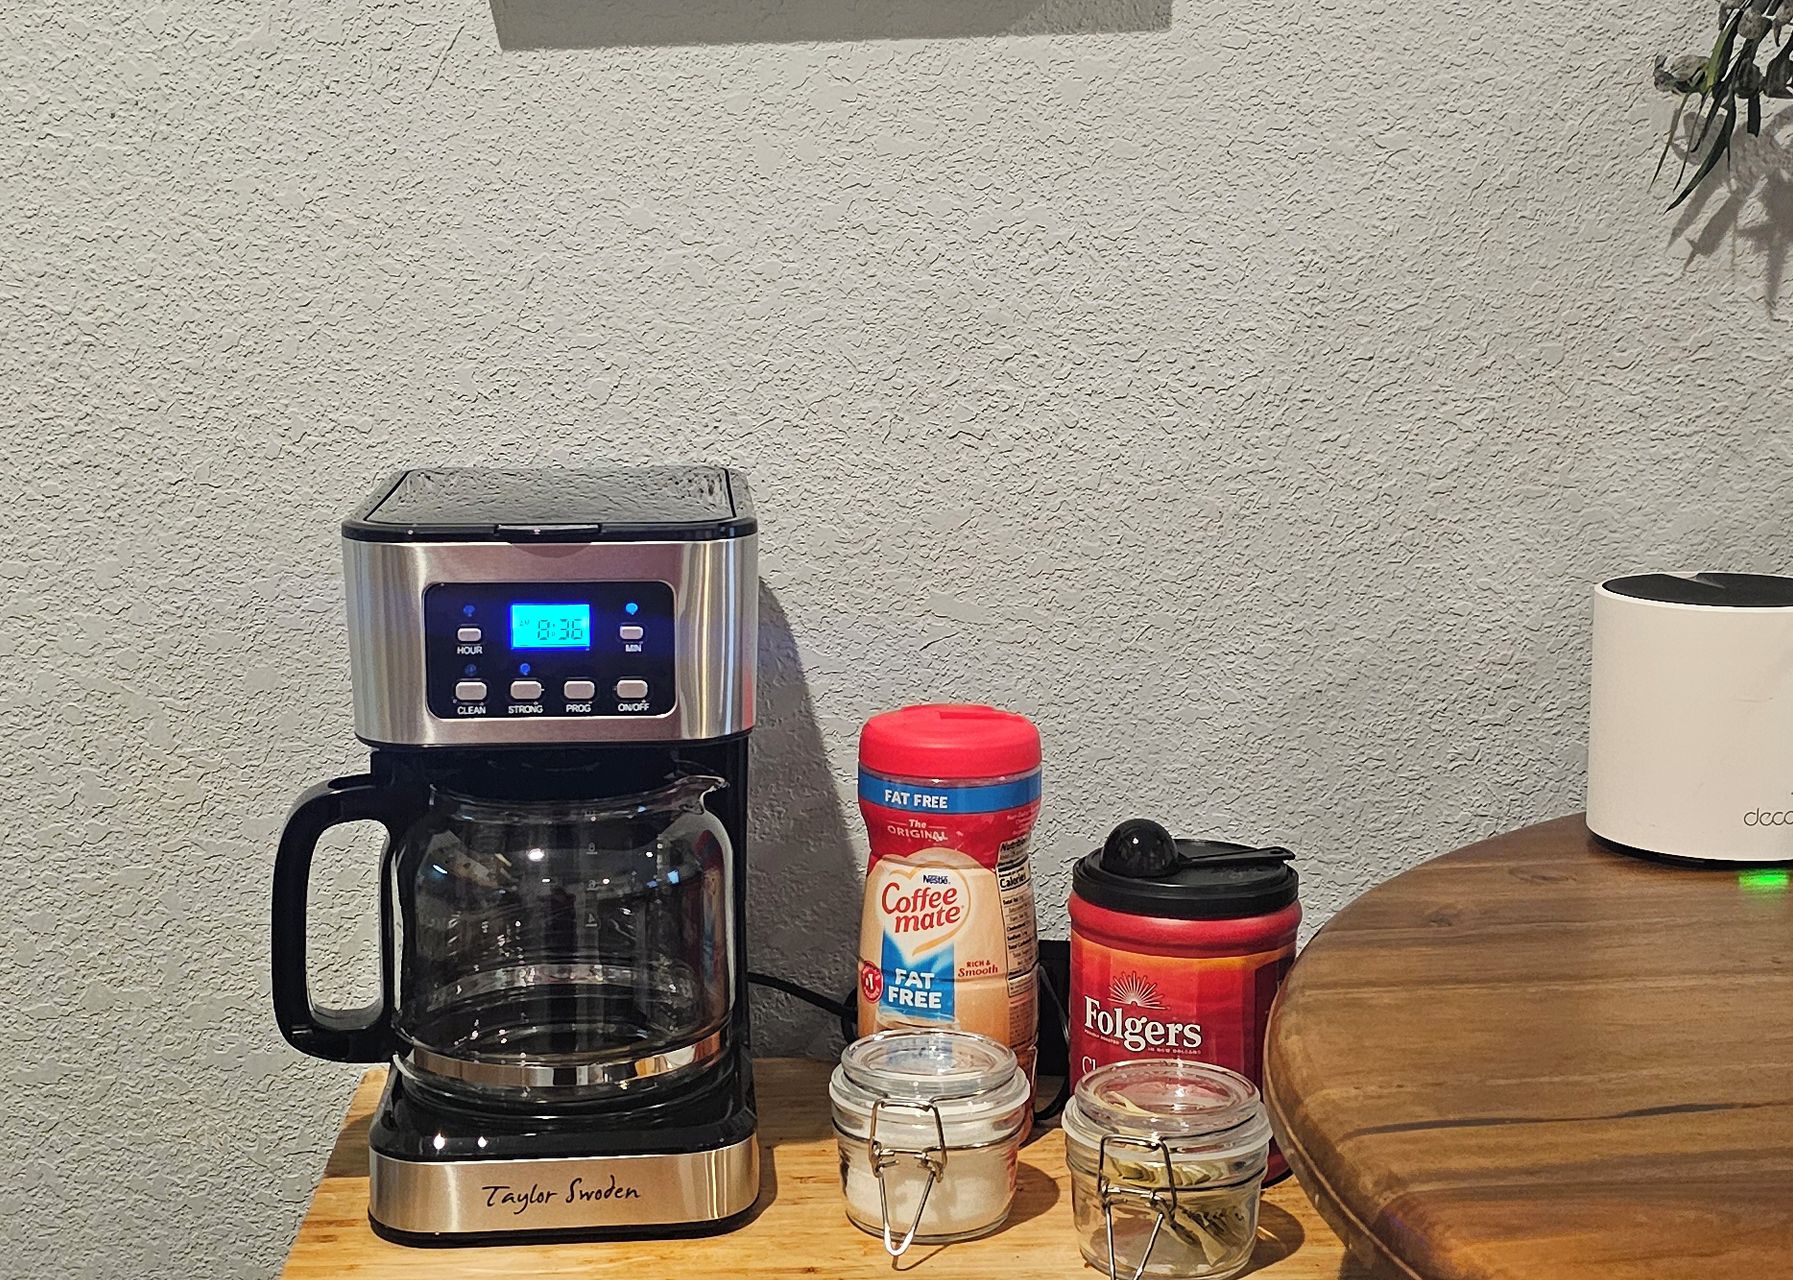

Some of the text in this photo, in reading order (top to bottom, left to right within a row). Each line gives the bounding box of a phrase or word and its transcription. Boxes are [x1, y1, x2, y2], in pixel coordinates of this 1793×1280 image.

[537, 618, 583, 641] 8:36
[457, 645, 483, 655] HOUR
[625, 644, 642, 652] MIN
[457, 706, 487, 715] CLEAN
[508, 705, 543, 714] STRONG
[566, 704, 591, 713] PROG
[618, 702, 650, 711] ON/OFF
[885, 789, 948, 809] FAT FREE
[909, 819, 927, 829] The
[887, 825, 949, 842] ORIGINAL
[882, 882, 958, 915] Coffee
[894, 906, 961, 933] mate
[957, 964, 998, 977] Smooth
[966, 960, 985, 968] RICH
[895, 968, 935, 990] FAT
[888, 985, 942, 1009] FREE
[1084, 994, 1202, 1053] Folgers
[482, 1174, 640, 1215] Taylor Swoden
